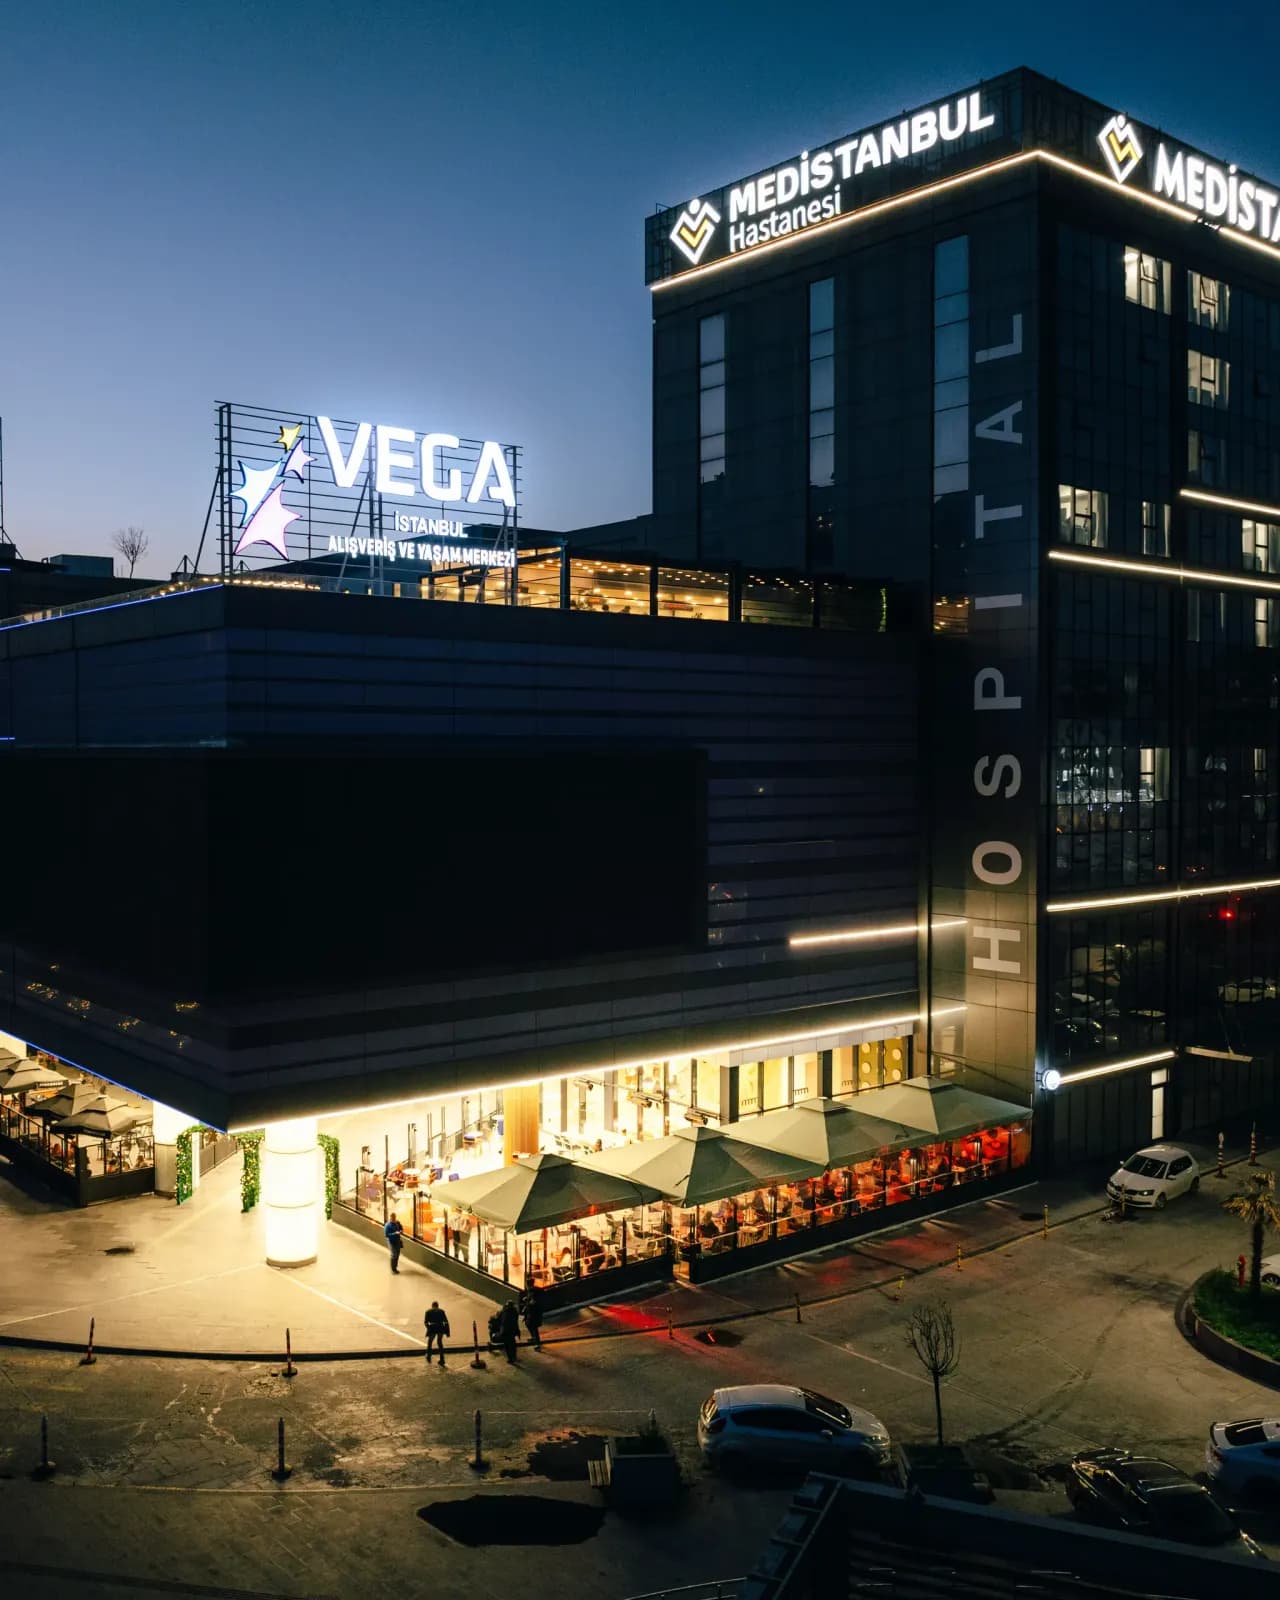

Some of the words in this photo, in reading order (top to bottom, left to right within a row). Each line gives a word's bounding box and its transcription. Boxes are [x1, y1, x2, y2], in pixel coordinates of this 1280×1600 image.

[728, 91, 995, 223] MEDİSTANBUL
[729, 184, 842, 253] Hastanesi
[316, 415, 516, 507] VEGA
[328, 535, 396, 561] ALIŞVERİŞ
[398, 541, 415, 559] VE
[417, 543, 462, 565] YAŞAM
[462, 548, 516, 568] MERKEZİ
[394, 511, 468, 538] İSTANBUL
[972, 313, 1023, 975] HOSPITAL
